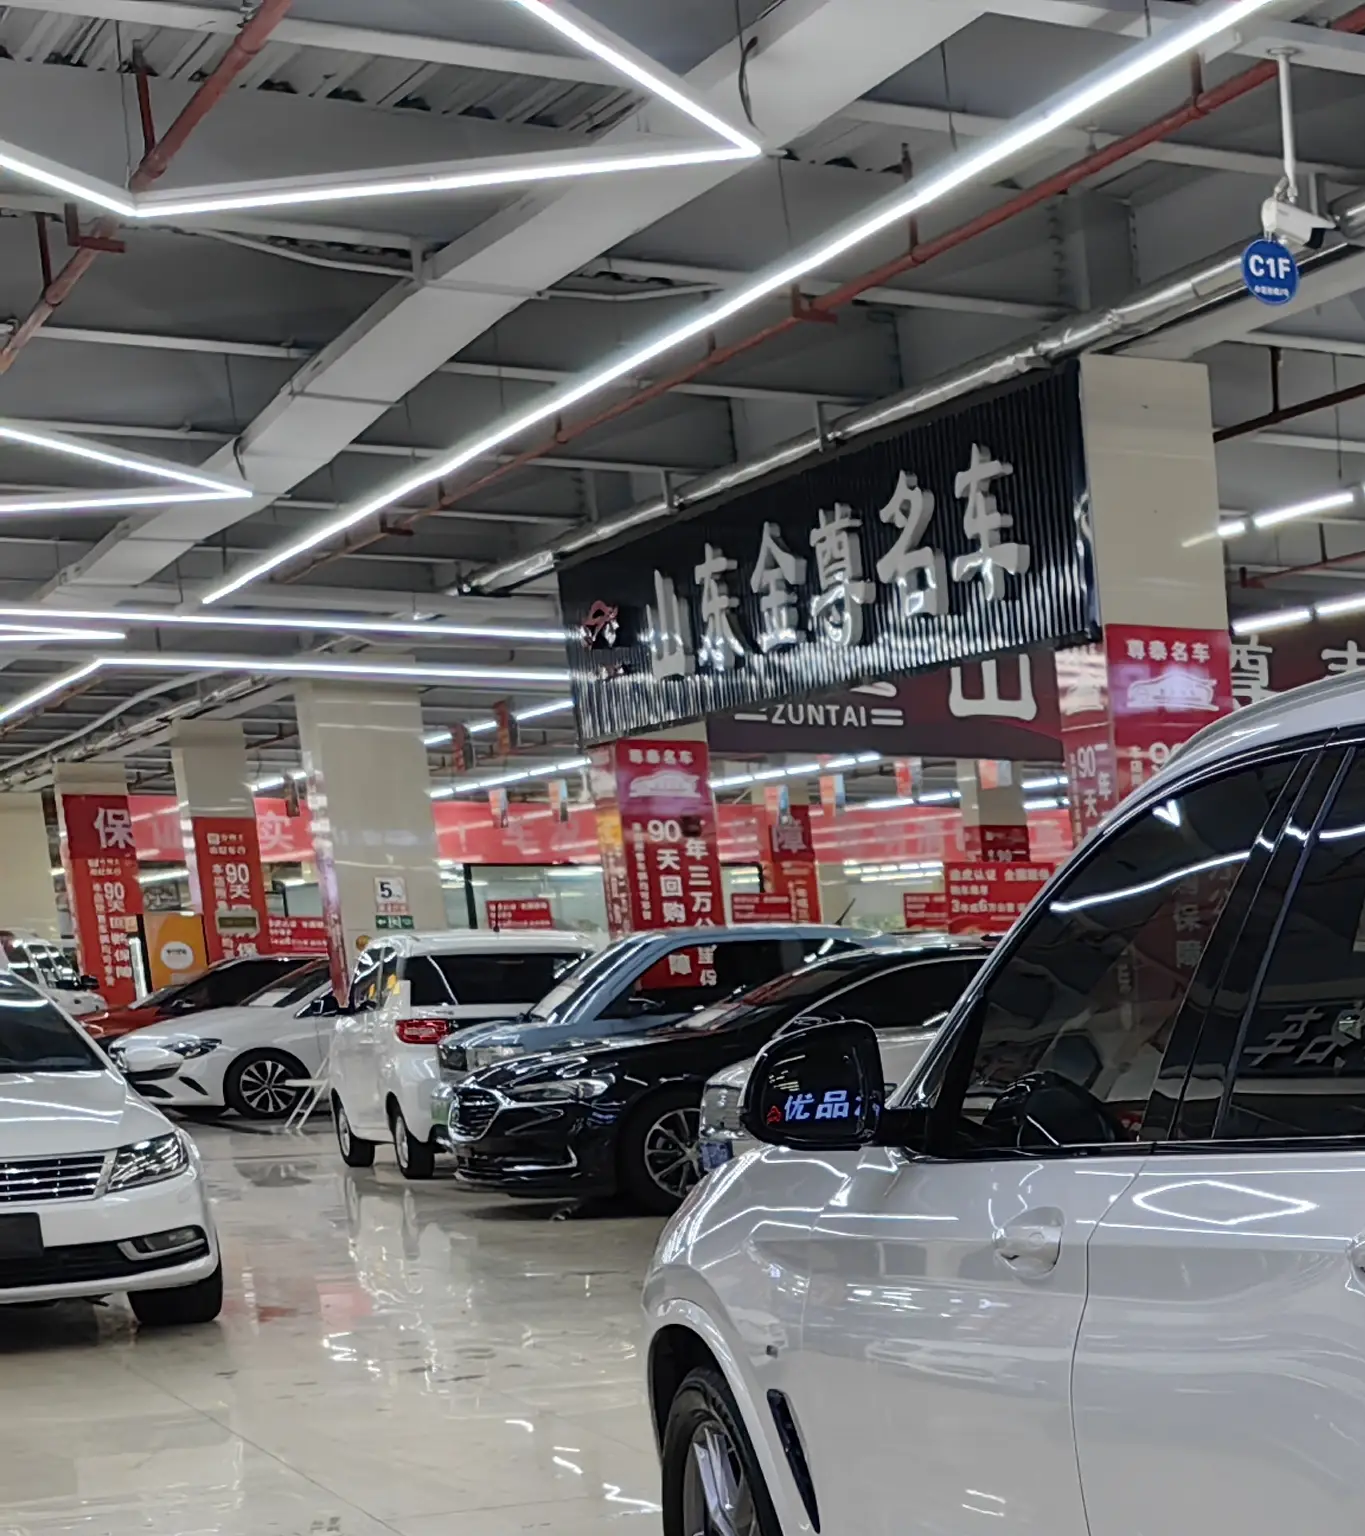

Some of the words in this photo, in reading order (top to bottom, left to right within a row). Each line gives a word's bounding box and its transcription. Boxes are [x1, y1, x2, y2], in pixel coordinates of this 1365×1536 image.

[1248, 254, 1291, 279] C1F
[637, 442, 1030, 683] 山东金尊名车
[771, 704, 867, 728] ZUNTAI
[379, 881, 393, 899] 5
